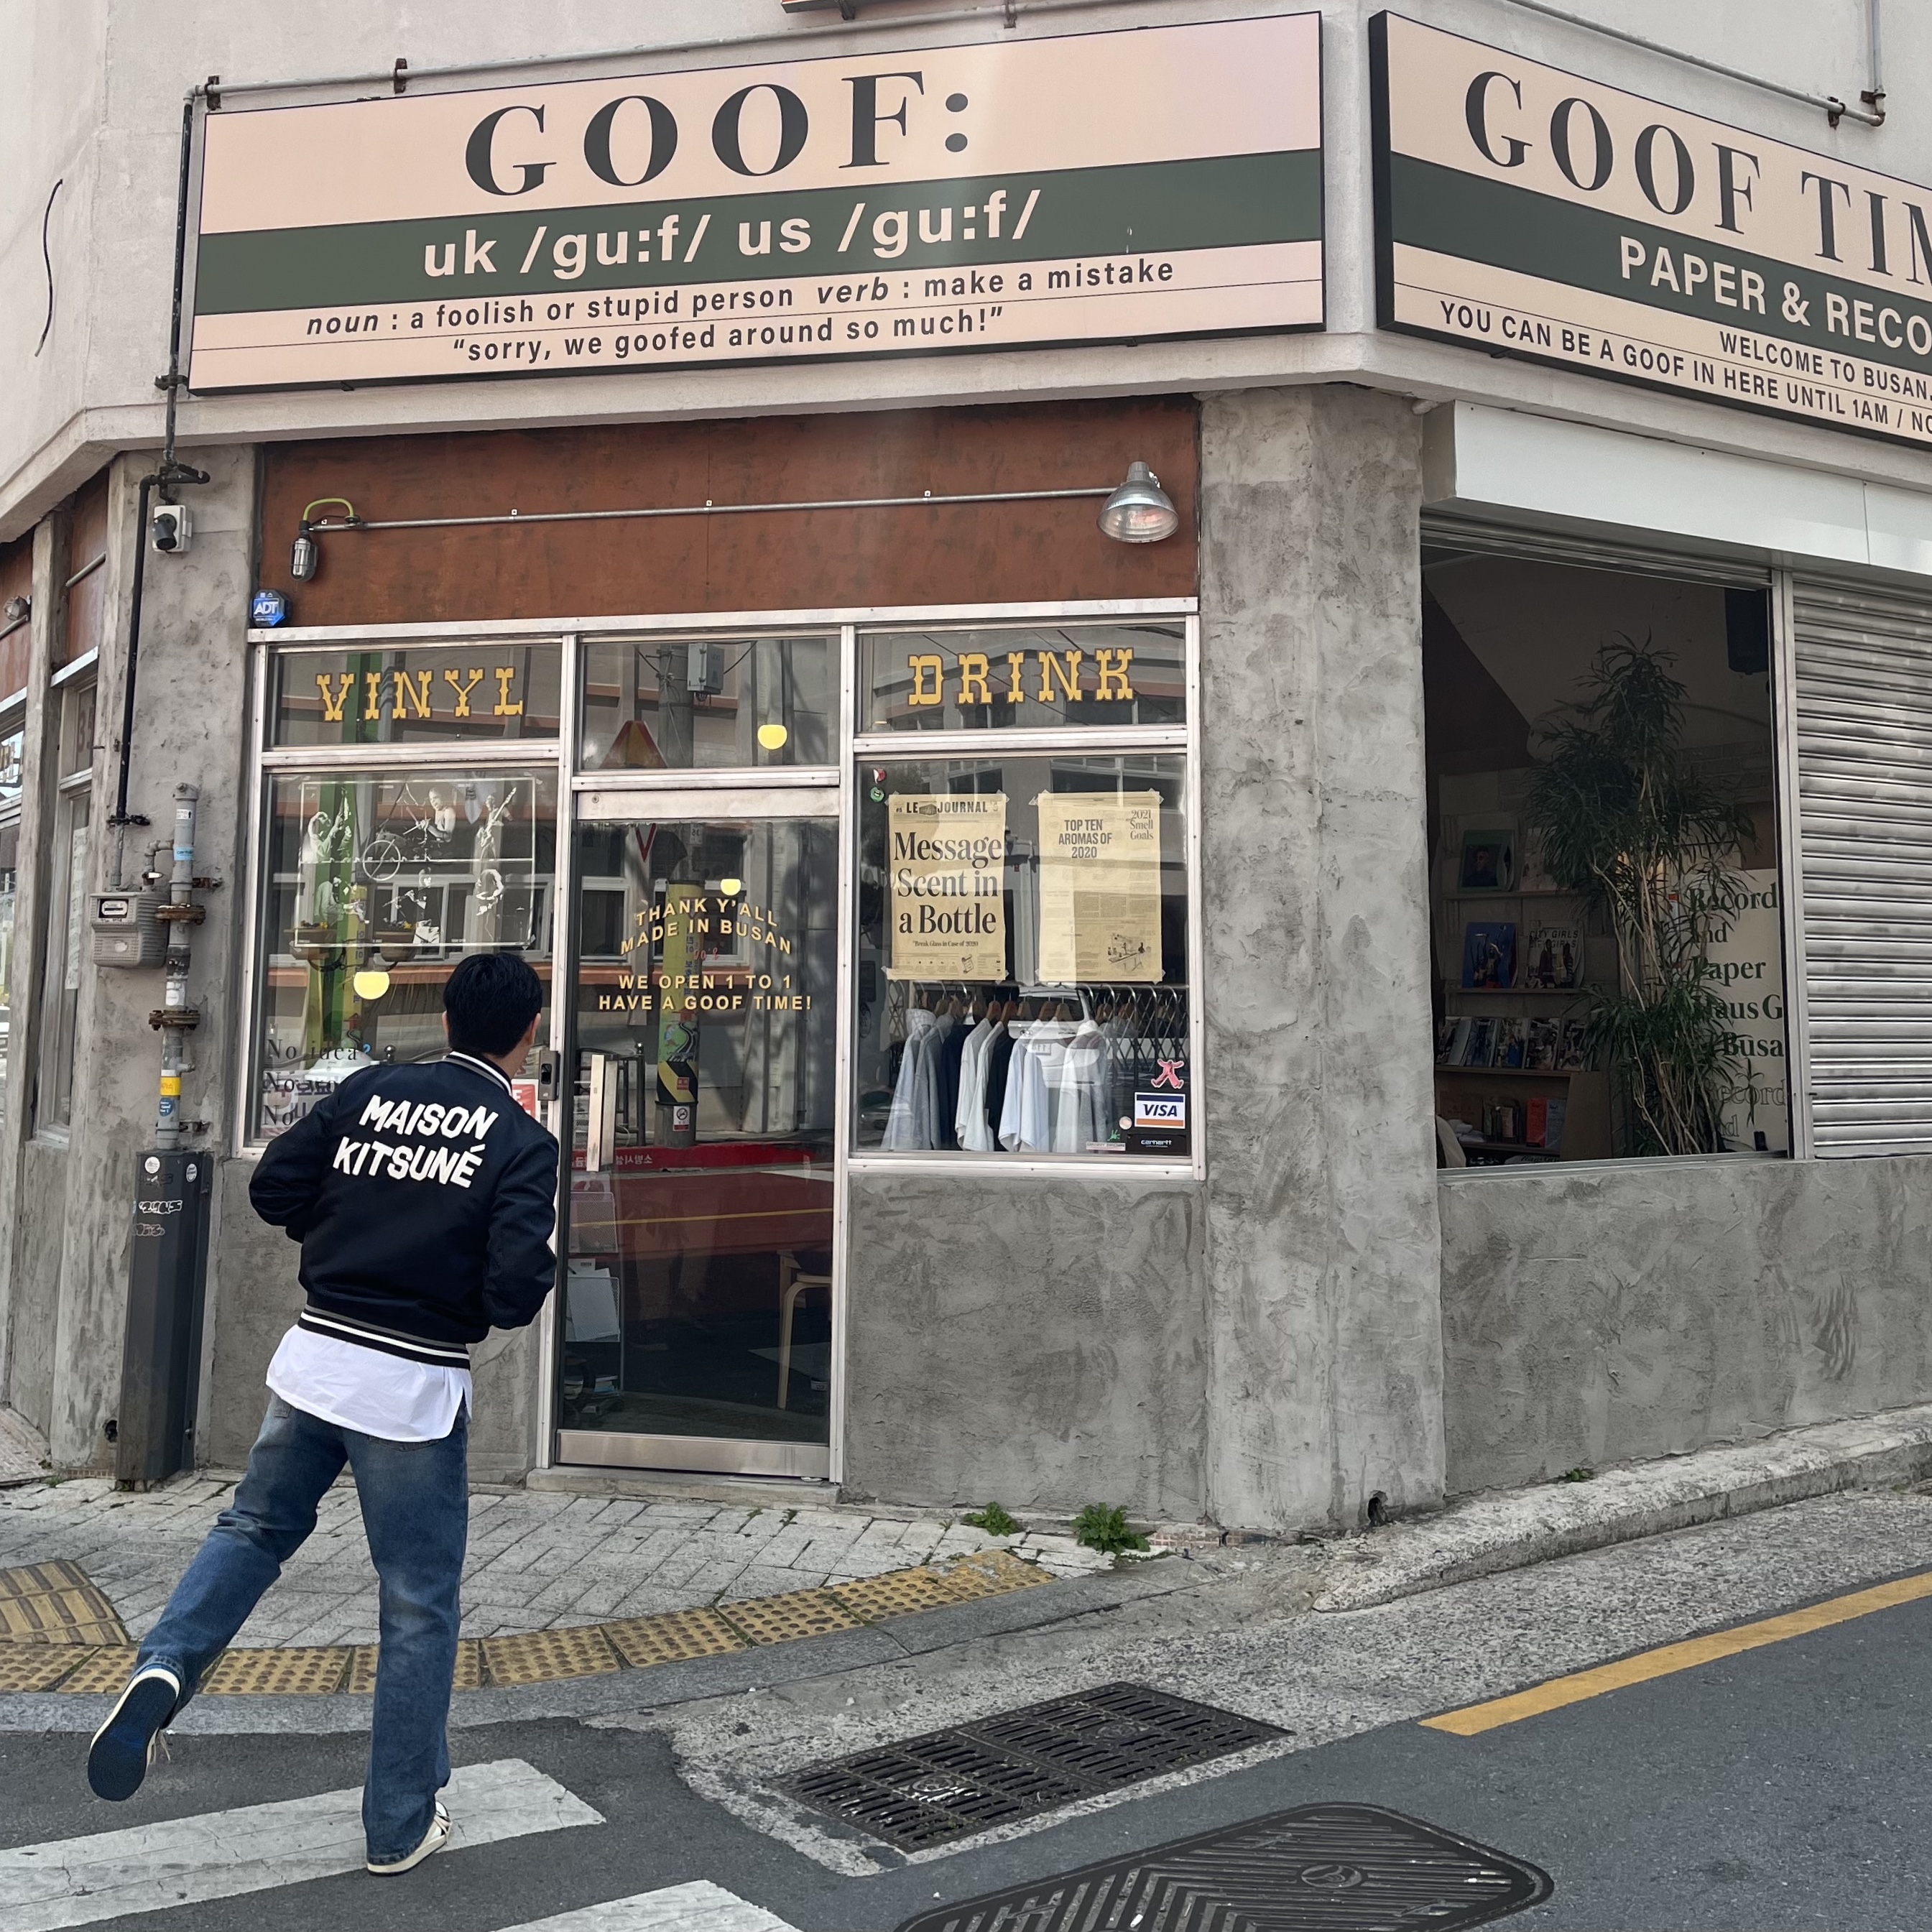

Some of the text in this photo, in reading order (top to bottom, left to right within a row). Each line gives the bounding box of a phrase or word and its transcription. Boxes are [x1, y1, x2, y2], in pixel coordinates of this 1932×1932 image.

[465, 70, 969, 195] GOOF:
[1465, 71, 1761, 235] GOOF
[425, 189, 1041, 280] uk /gu:f/ us /gu:f/
[1619, 236, 1767, 315] PAPER
[1781, 282, 1811, 326] &
[307, 313, 379, 335] noun
[410, 310, 424, 330] a
[436, 300, 534, 328] foolish
[547, 300, 574, 322] or
[587, 290, 679, 323] stupid
[692, 285, 793, 318] person
[816, 276, 889, 305] verb
[924, 270, 1004, 297] make
[1018, 272, 1033, 291] a
[1048, 259, 1174, 289] mistake
[565, 335, 603, 356] we
[615, 324, 715, 359] goofed
[728, 318, 833, 346] around
[846, 318, 879, 338] so
[1440, 300, 1492, 333] YOU
[1502, 317, 1552, 347] CAN
[1562, 328, 1591, 356] BE
[1599, 338, 1615, 361] A
[1623, 344, 1685, 377] GOOF
[1693, 360, 1715, 386] IN
[1724, 369, 1779, 400] HERE
[1786, 384, 1846, 416] UNTIL
[1852, 399, 1889, 425] 1AM
[1897, 408, 1903, 427] /
[1719, 331, 1824, 376] WELCOME
[1831, 359, 1856, 383] TO
[254, 601, 279, 615] ADT
[908, 647, 1134, 706] DRINK
[315, 667, 523, 721] VINYL
[906, 802, 918, 813] LE
[937, 801, 988, 813] JOURNAL
[1131, 810, 1151, 819] 2021
[1064, 819, 1103, 831] TOP TEN
[1129, 819, 1153, 830] Smell
[1130, 830, 1154, 840] Goals
[894, 832, 1002, 869] Message
[1059, 833, 1112, 845] AROMAS OF
[1071, 846, 1097, 859] 2020
[897, 868, 998, 897] Scent in
[635, 898, 708, 927] THANK
[899, 902, 997, 934] a Bottle
[620, 919, 790, 955] MADE IN BUSAN
[1552, 930, 1579, 938] GIRLS
[1692, 922, 1728, 943] nd
[619, 975, 791, 989] WE OPEN 1 TO 1
[598, 995, 812, 1010] HAVE A GOOF TIME!
[1696, 995, 1759, 1020] aus
[267, 1039, 297, 1060] No
[265, 1072, 295, 1093] No
[264, 1105, 294, 1126] No
[359, 1094, 499, 1140] MAISON
[1143, 1104, 1178, 1117] VISA
[333, 1136, 486, 1188] KITSUNÉ
